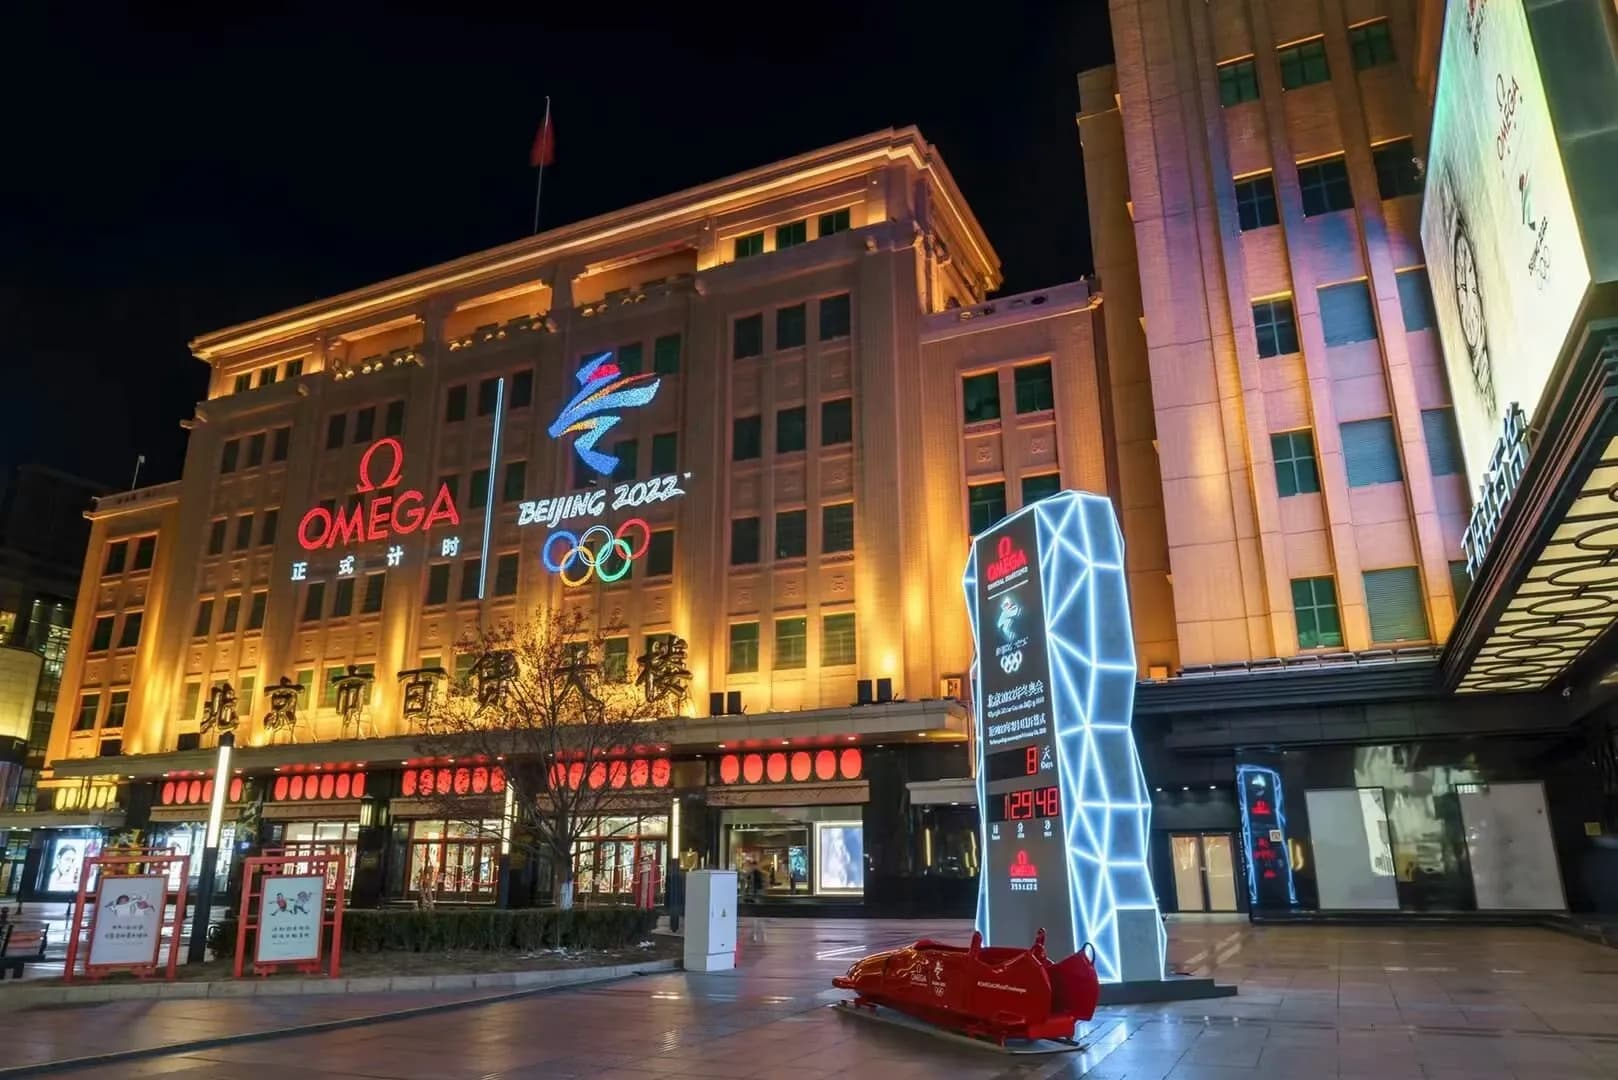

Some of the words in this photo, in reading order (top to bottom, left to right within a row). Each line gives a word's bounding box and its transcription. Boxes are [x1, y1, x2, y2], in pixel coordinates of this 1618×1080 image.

[297, 482, 460, 550] OMEGA
[518, 490, 606, 528] BEIJING
[612, 474, 686, 511] 2022
[291, 536, 460, 581] 正式计时
[1026, 746, 1038, 775] 8
